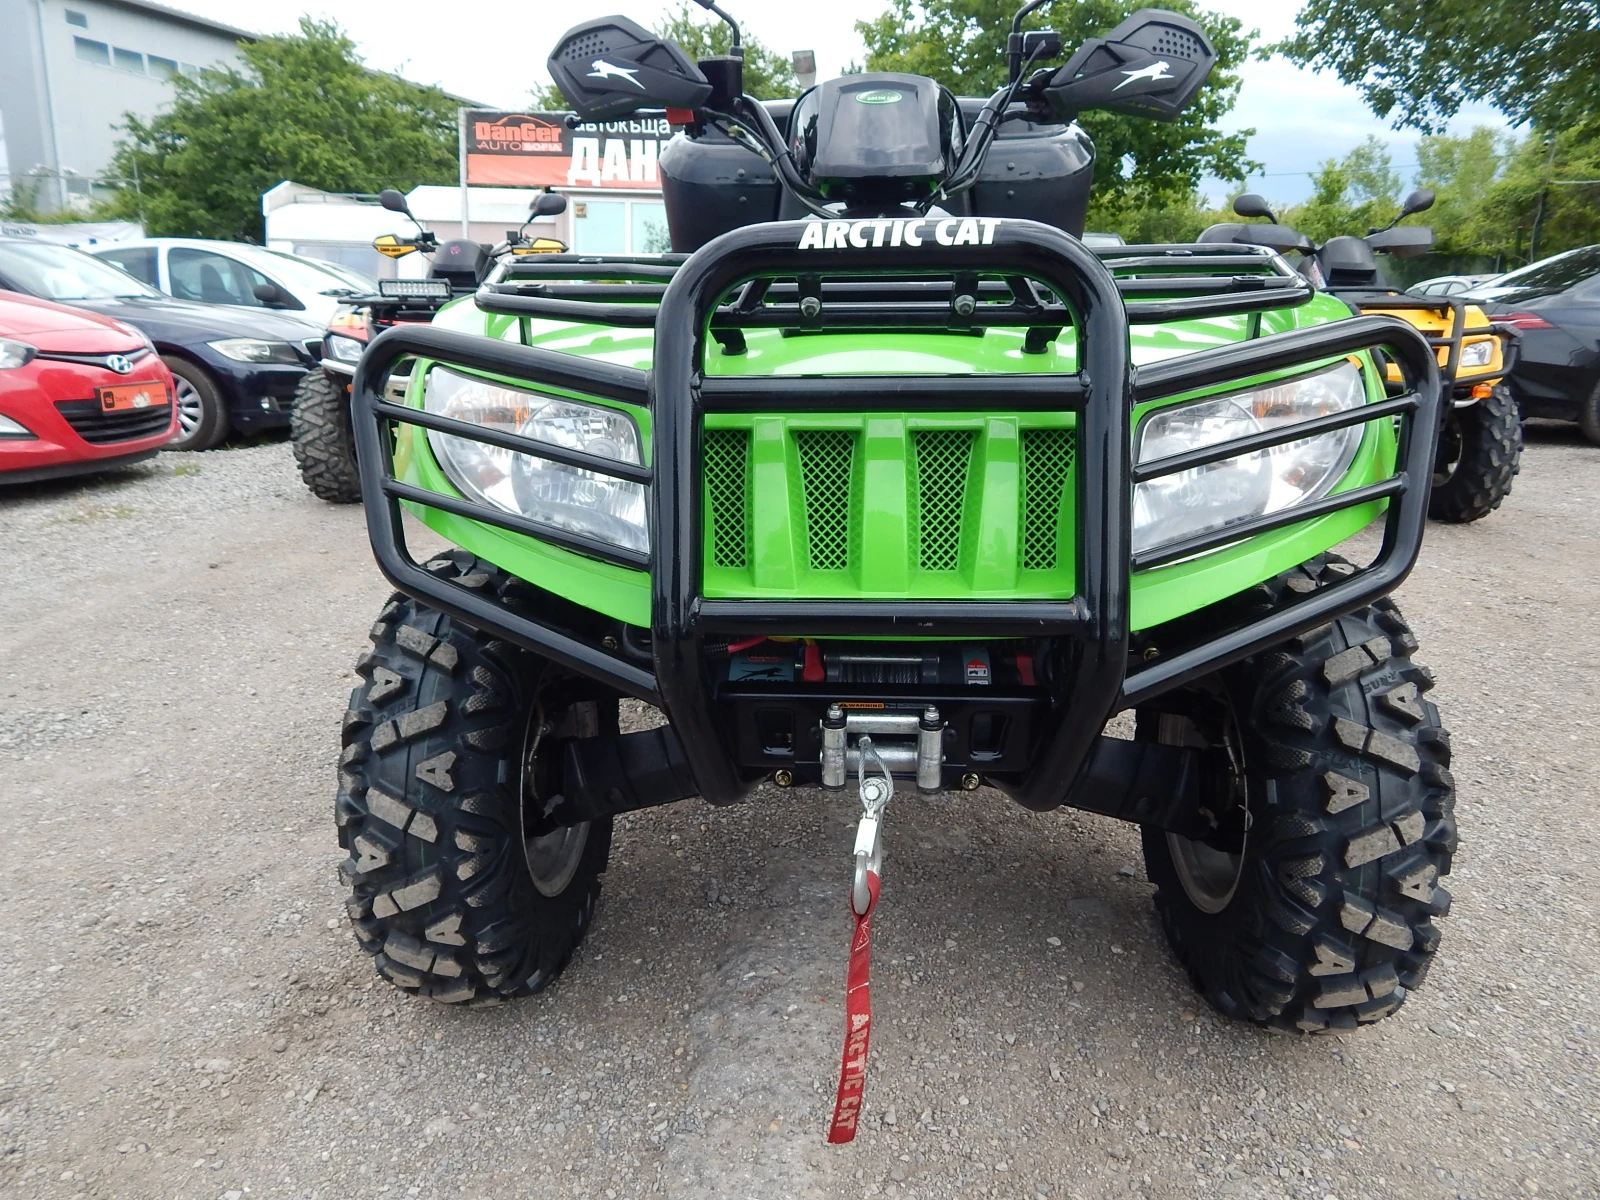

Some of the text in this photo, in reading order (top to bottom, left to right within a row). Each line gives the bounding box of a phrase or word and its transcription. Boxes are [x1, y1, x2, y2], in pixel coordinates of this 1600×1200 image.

[567, 137, 668, 186] ДАН
[798, 219, 1001, 249] ARCTIC CAT
[836, 1014, 869, 1129] ARCTIC CAT
